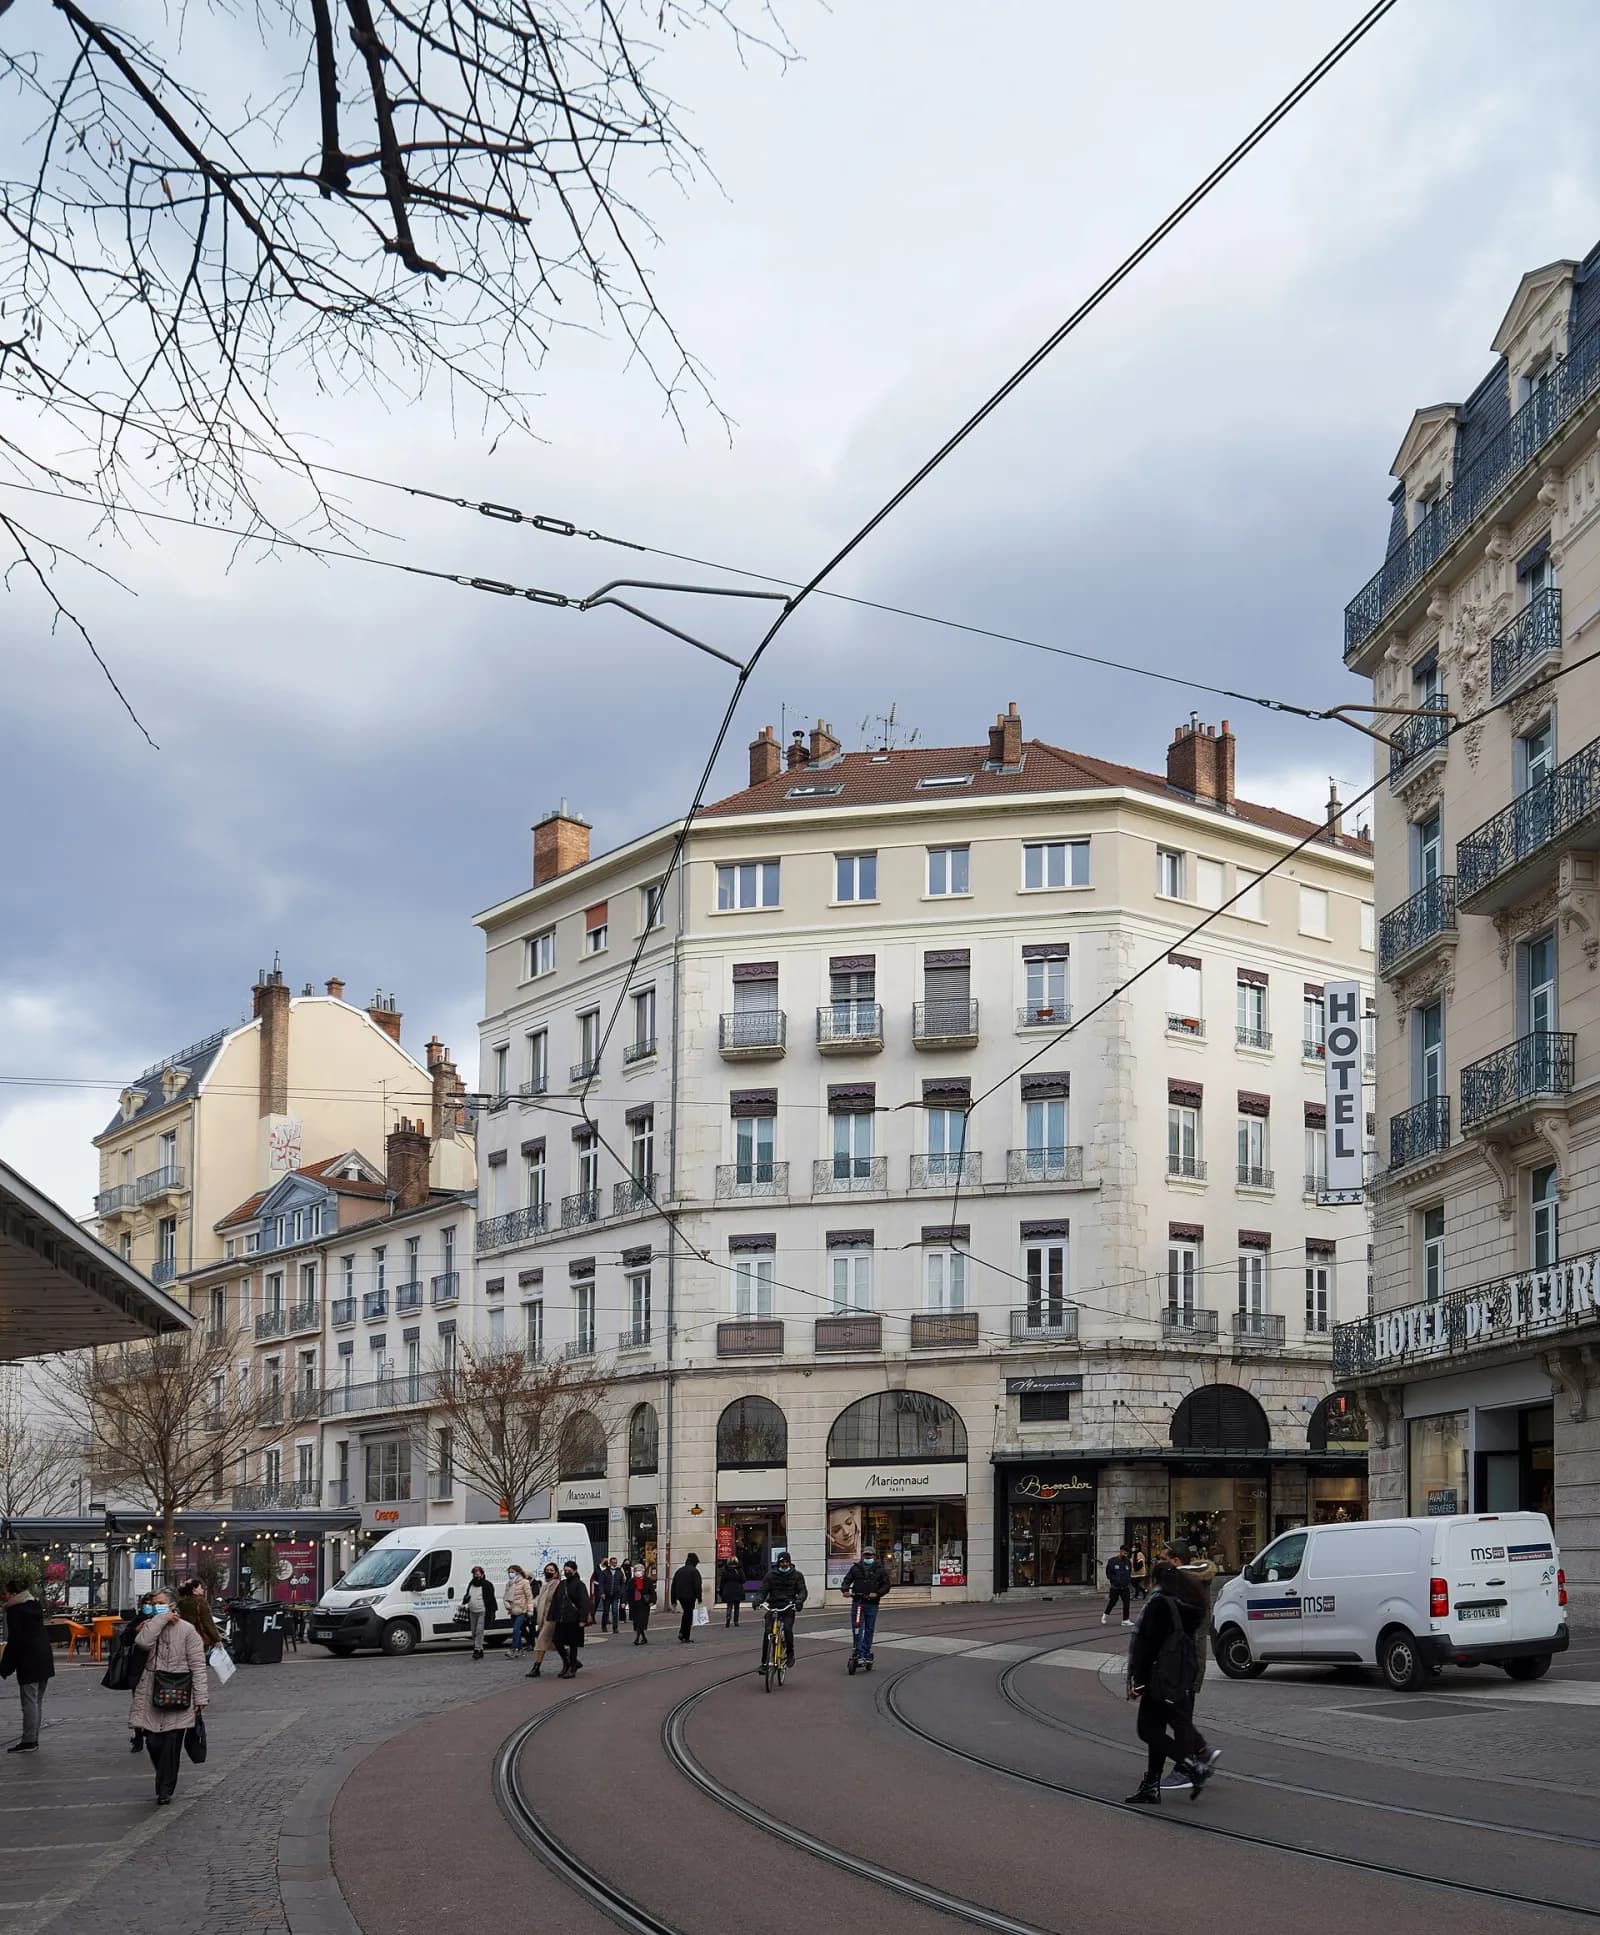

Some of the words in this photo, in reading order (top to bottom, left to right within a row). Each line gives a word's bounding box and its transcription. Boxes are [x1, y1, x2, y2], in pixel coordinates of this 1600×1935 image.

[1328, 992, 1358, 1158] HOTEL
[1465, 1300, 1494, 1338] DE
[865, 1473, 929, 1489] Marionnaud
[375, 1509, 400, 1523] Orange
